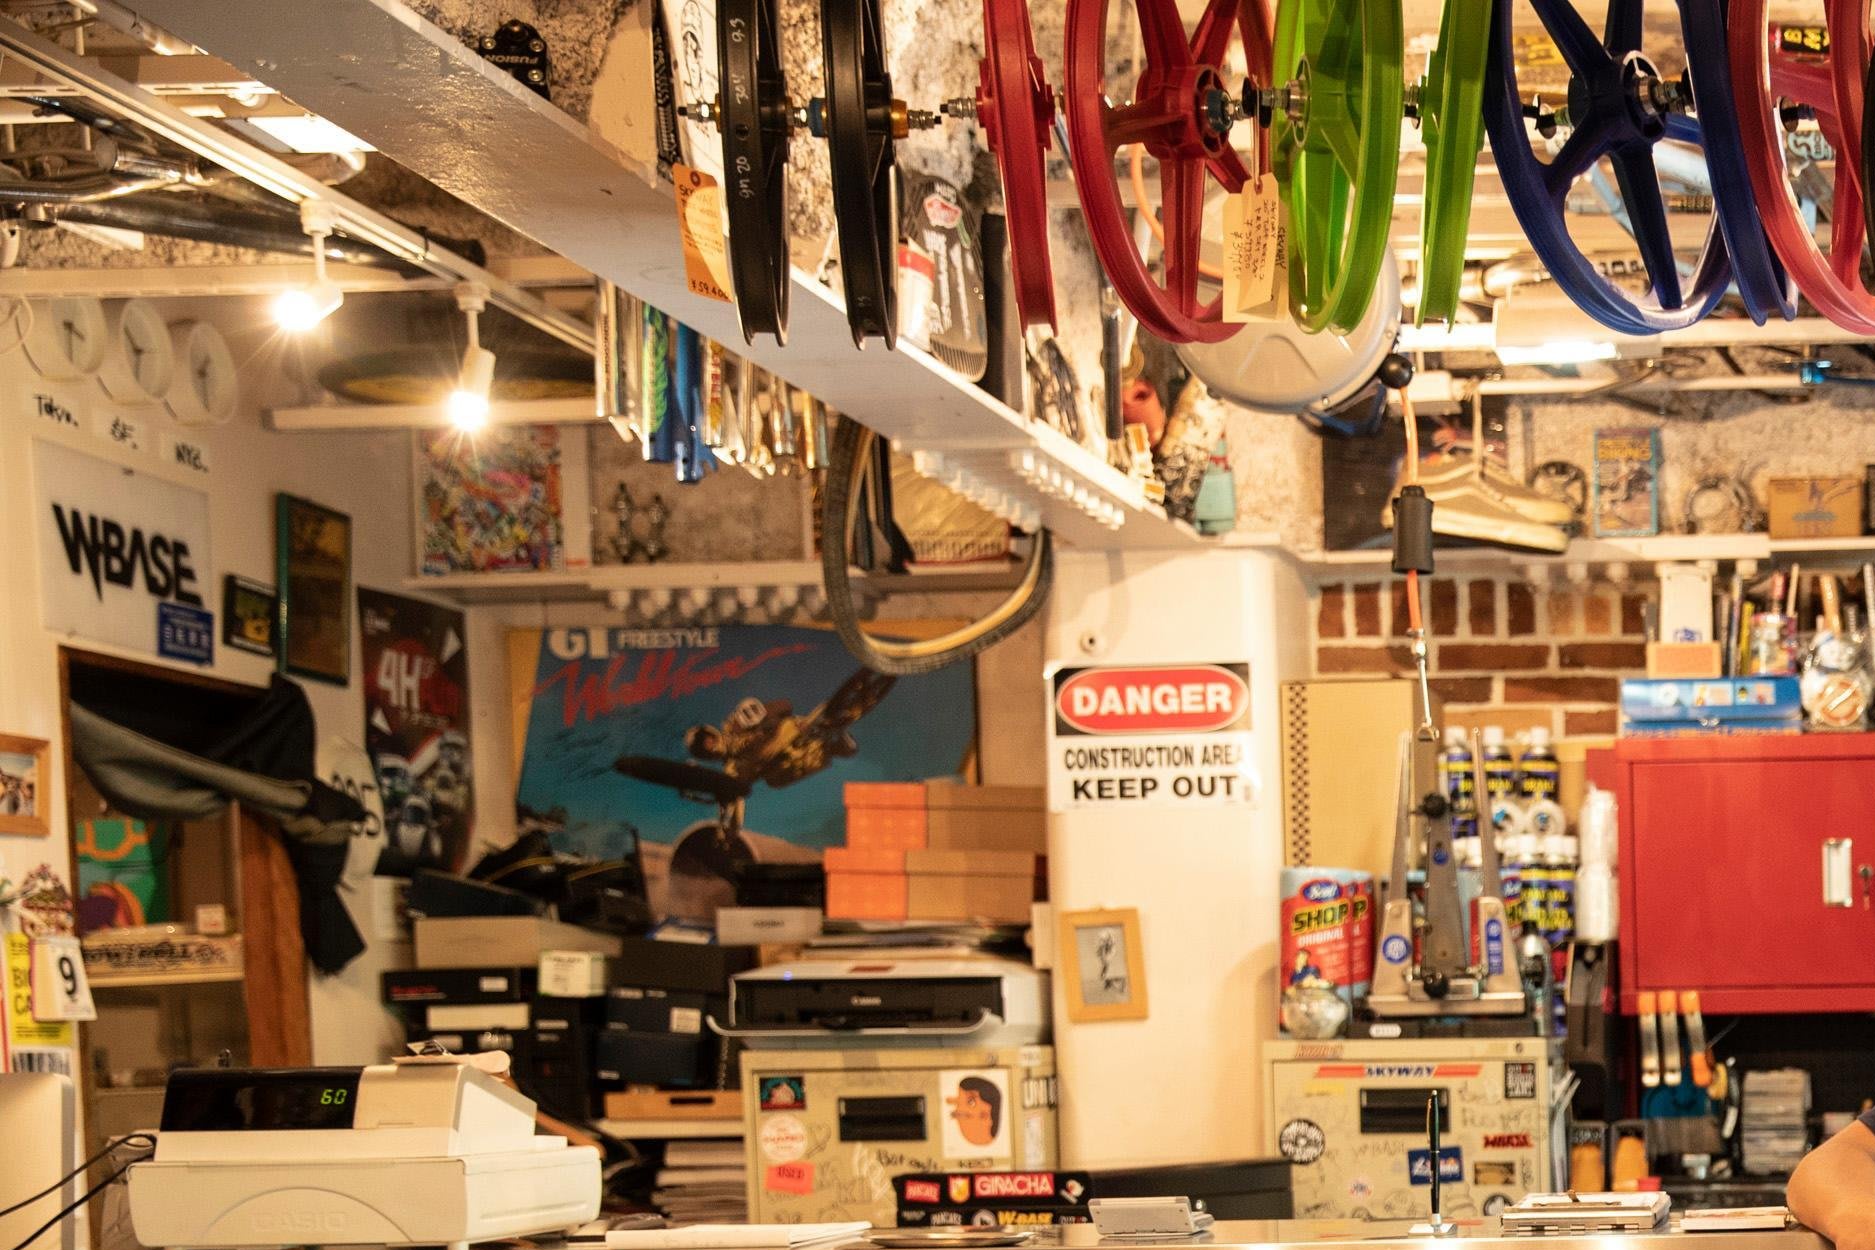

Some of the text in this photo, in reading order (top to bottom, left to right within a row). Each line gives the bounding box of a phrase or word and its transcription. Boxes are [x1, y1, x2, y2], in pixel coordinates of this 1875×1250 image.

[484, 53, 540, 65] FUSION
[548, 626, 610, 660] GT
[617, 627, 720, 650] FREESTYLE
[1072, 682, 1233, 717] DANGER
[1064, 744, 1195, 770] CONSTRUCTION
[1073, 775, 1238, 800] KEEP OUT
[1310, 882, 1339, 901] Scott
[1293, 900, 1349, 932] SHOP
[1296, 928, 1346, 949] ORIGINAL
[58, 956, 77, 995] 9
[1365, 1066, 1435, 1078] SKYWAY
[320, 1088, 347, 1106] 60
[251, 1210, 347, 1232] CASIO
